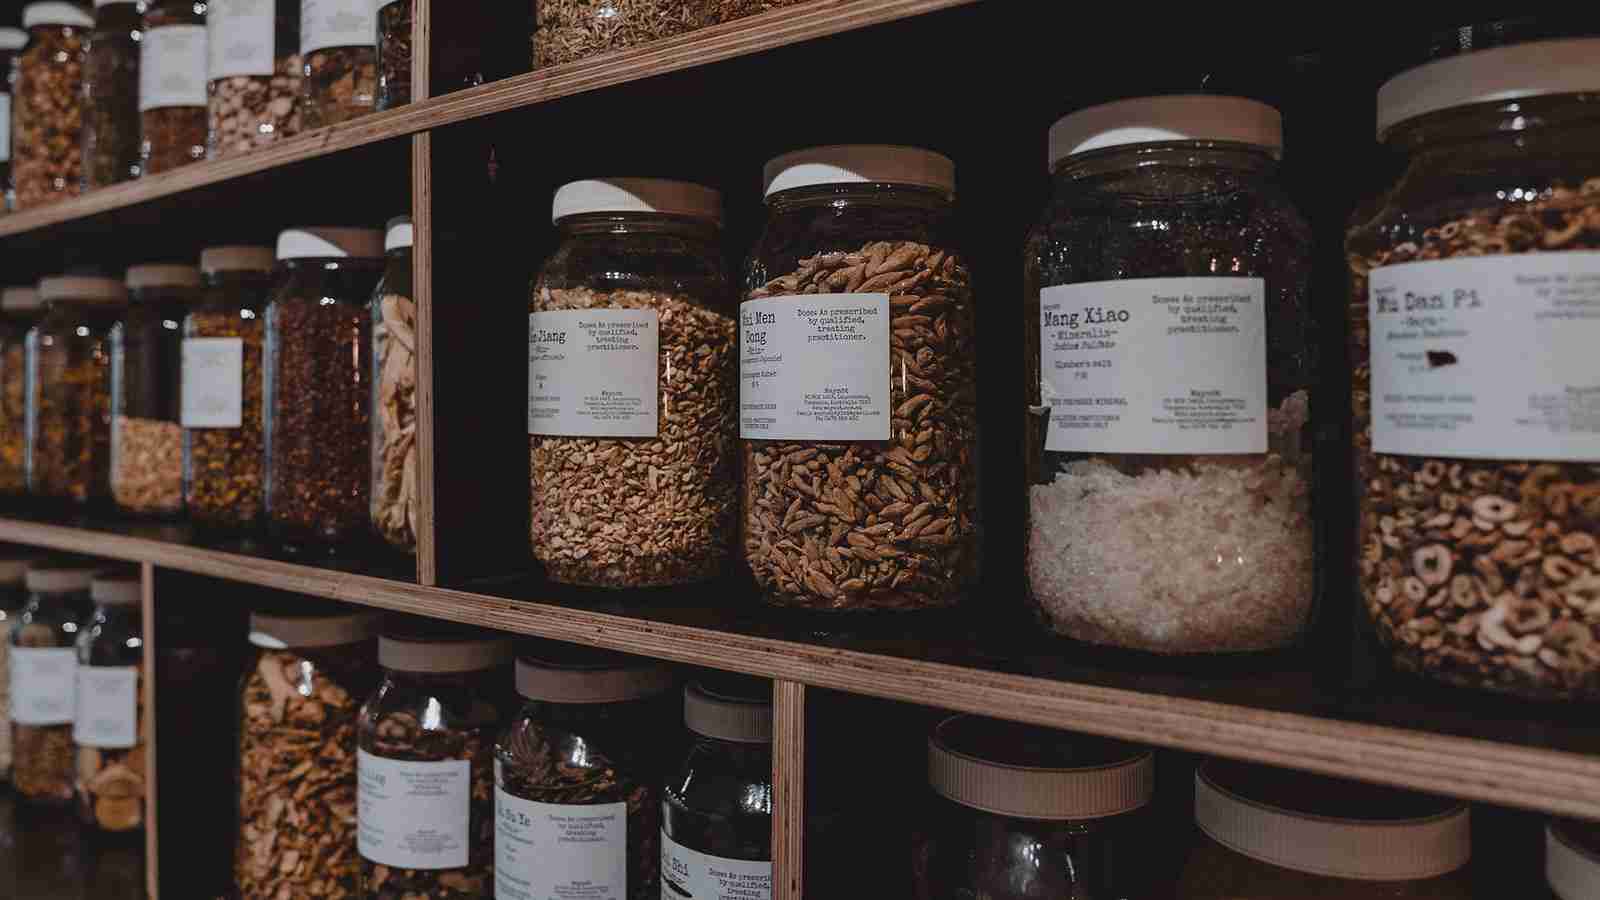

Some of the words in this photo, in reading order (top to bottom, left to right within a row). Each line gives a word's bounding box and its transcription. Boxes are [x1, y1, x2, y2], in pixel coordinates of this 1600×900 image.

[1404, 291, 1444, 312] Dan
[1453, 288, 1482, 309] Pi
[830, 307, 878, 316] prescribed
[755, 311, 776, 325] Men
[819, 316, 865, 325] qualified,
[1043, 311, 1079, 329] Mang
[1084, 307, 1130, 324] Xiao
[1180, 315, 1227, 325] treating
[817, 325, 856, 334] treating
[538, 329, 567, 345] Jiang
[596, 337, 630, 345] treating
[807, 333, 867, 343] practitioner.
